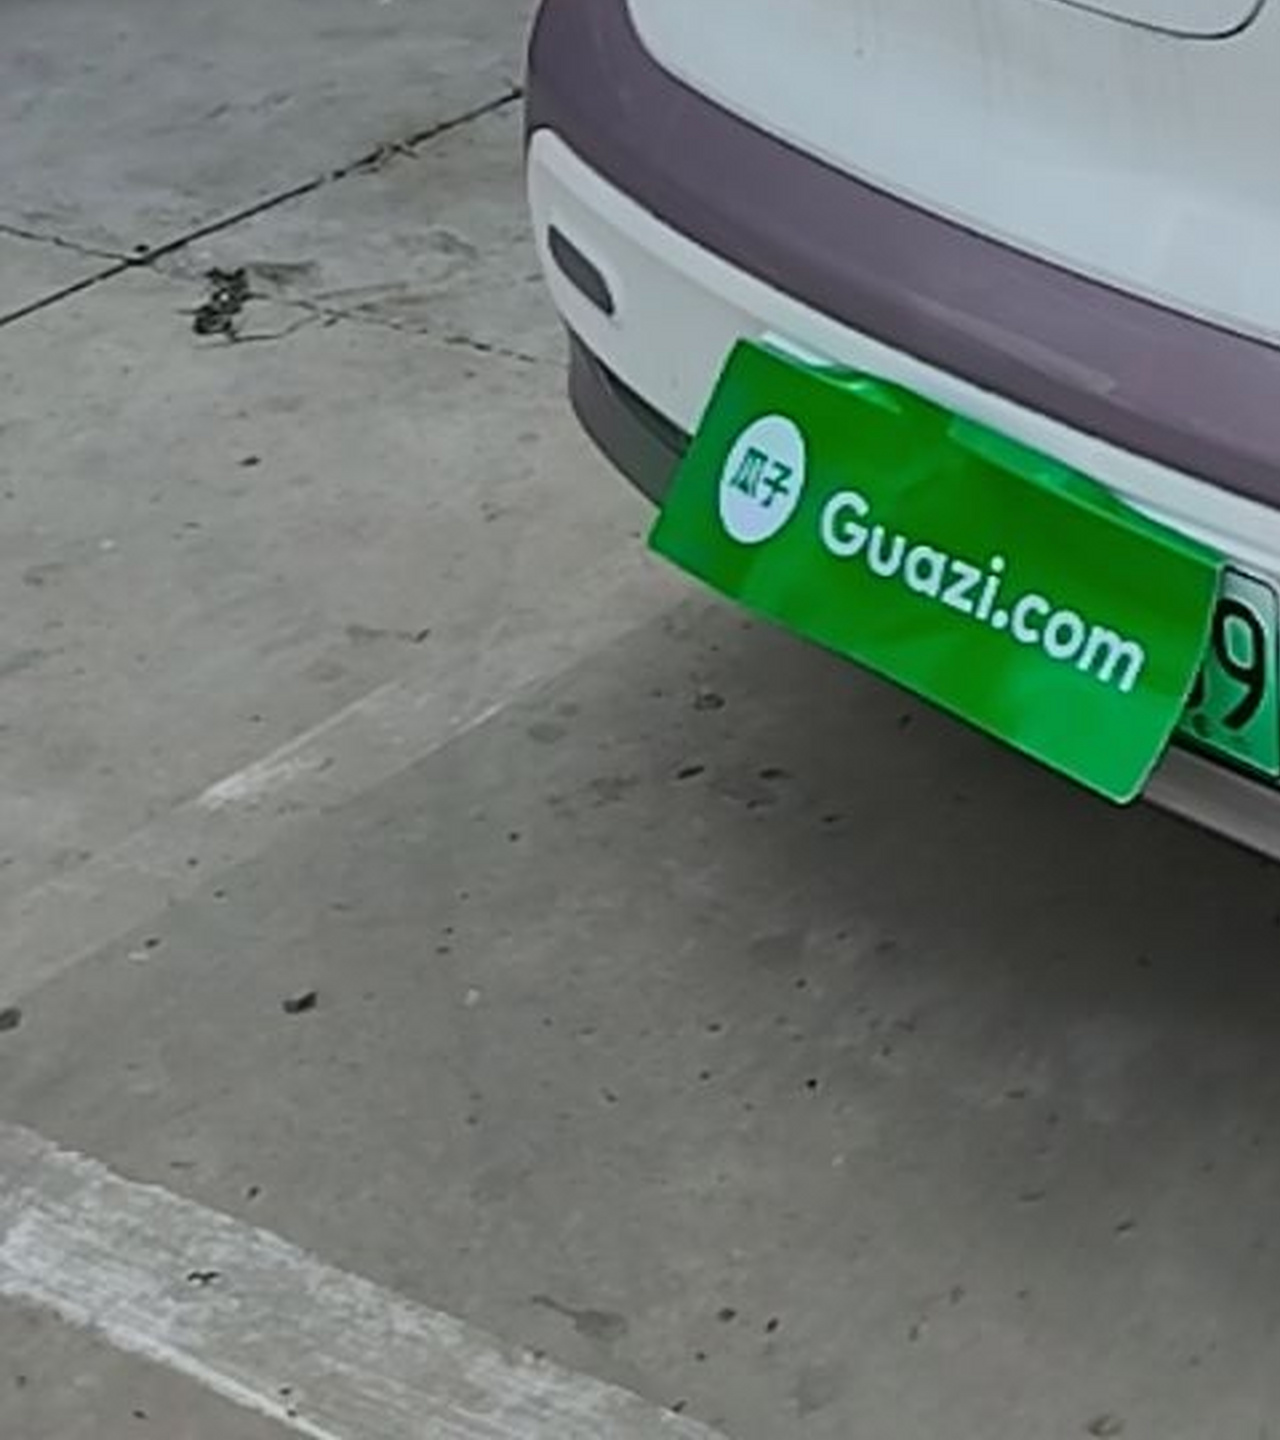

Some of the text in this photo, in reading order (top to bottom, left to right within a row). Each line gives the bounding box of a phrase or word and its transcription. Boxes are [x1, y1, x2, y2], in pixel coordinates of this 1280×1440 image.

[730, 447, 793, 508] 瓜子
[820, 491, 1145, 693] Guazi.com
[1190, 598, 1266, 730] 9
